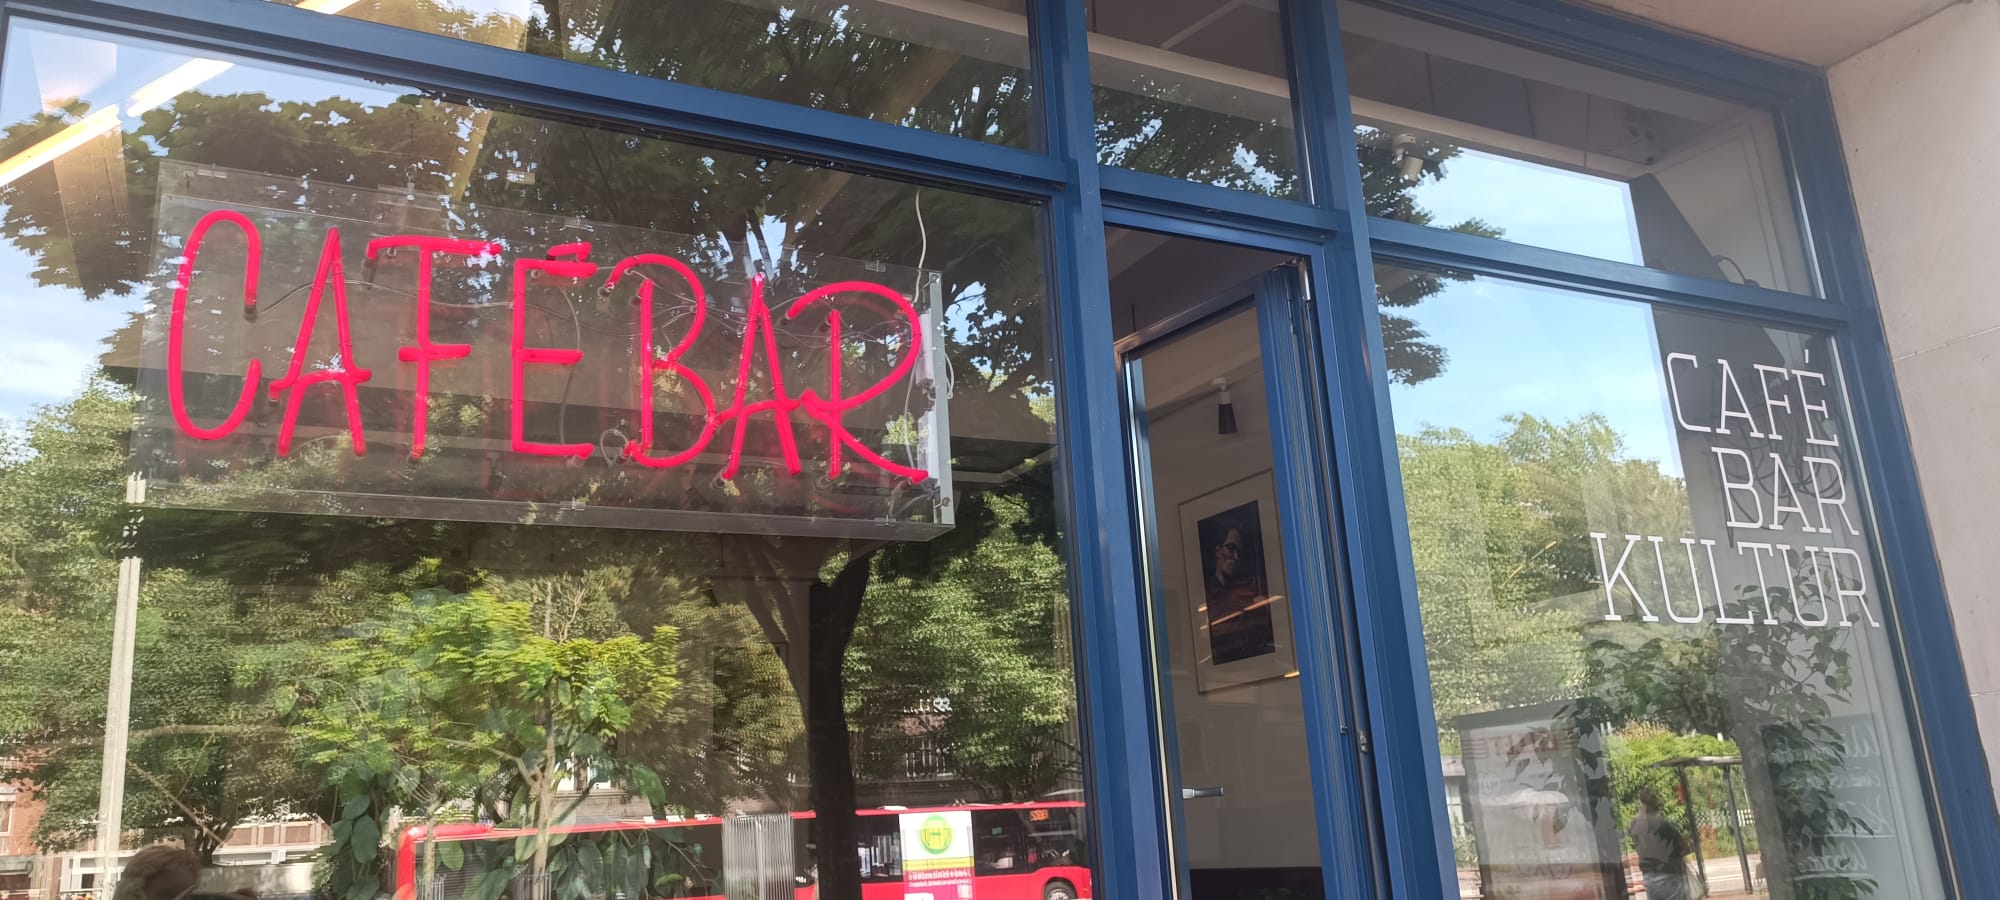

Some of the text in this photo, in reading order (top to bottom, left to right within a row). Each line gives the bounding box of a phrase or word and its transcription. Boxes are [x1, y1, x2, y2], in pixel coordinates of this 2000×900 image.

[168, 209, 929, 484] CAFÉ BAR
[1666, 349, 1839, 447] CAFÉ
[1711, 446, 1859, 536] BAR
[1590, 532, 1880, 628] KULTUR
